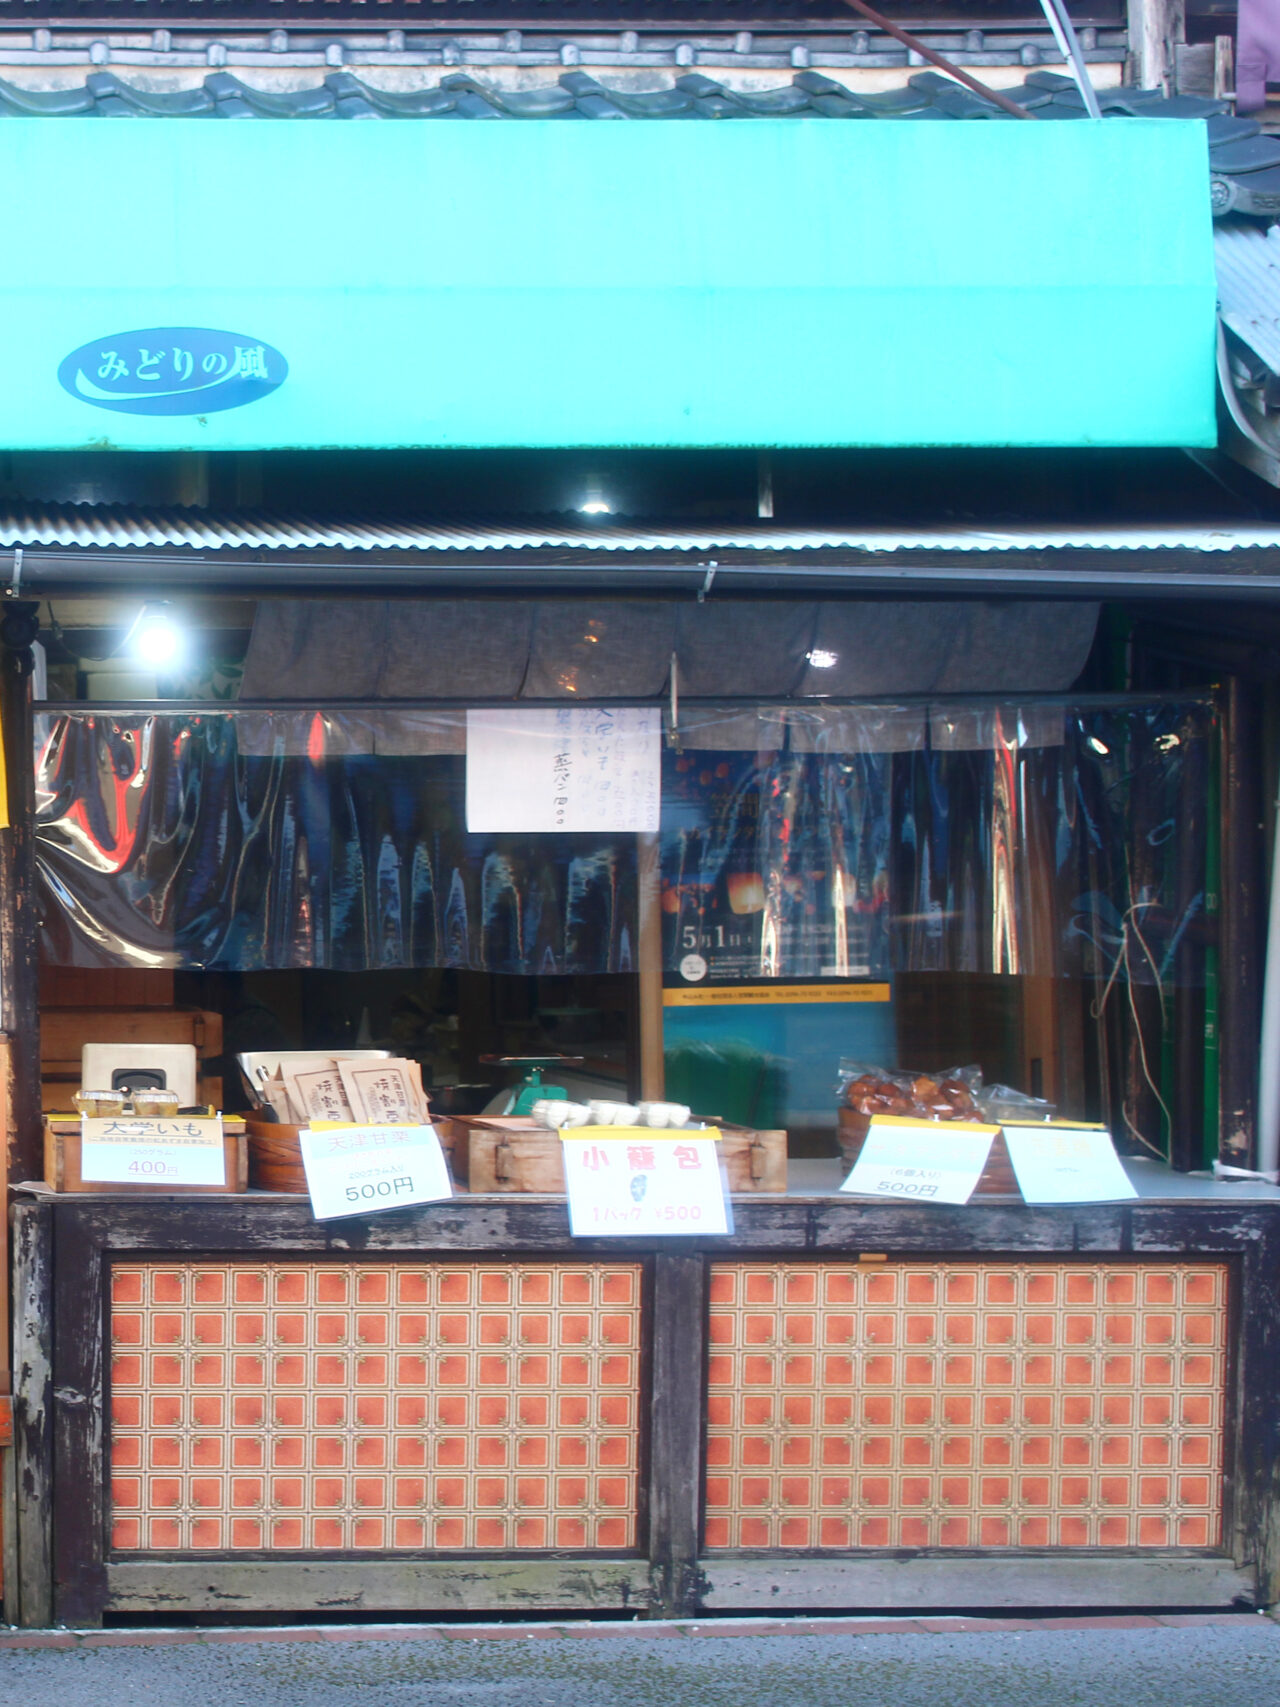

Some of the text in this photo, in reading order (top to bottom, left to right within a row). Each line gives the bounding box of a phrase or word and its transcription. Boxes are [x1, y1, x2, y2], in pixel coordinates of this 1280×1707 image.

[97, 345, 269, 381] みどりの風
[103, 1121, 203, 1137] 大学いも
[128, 1160, 178, 1174] 400円
[345, 1176, 415, 1202] 500円
[876, 1180, 939, 1197] 500円
